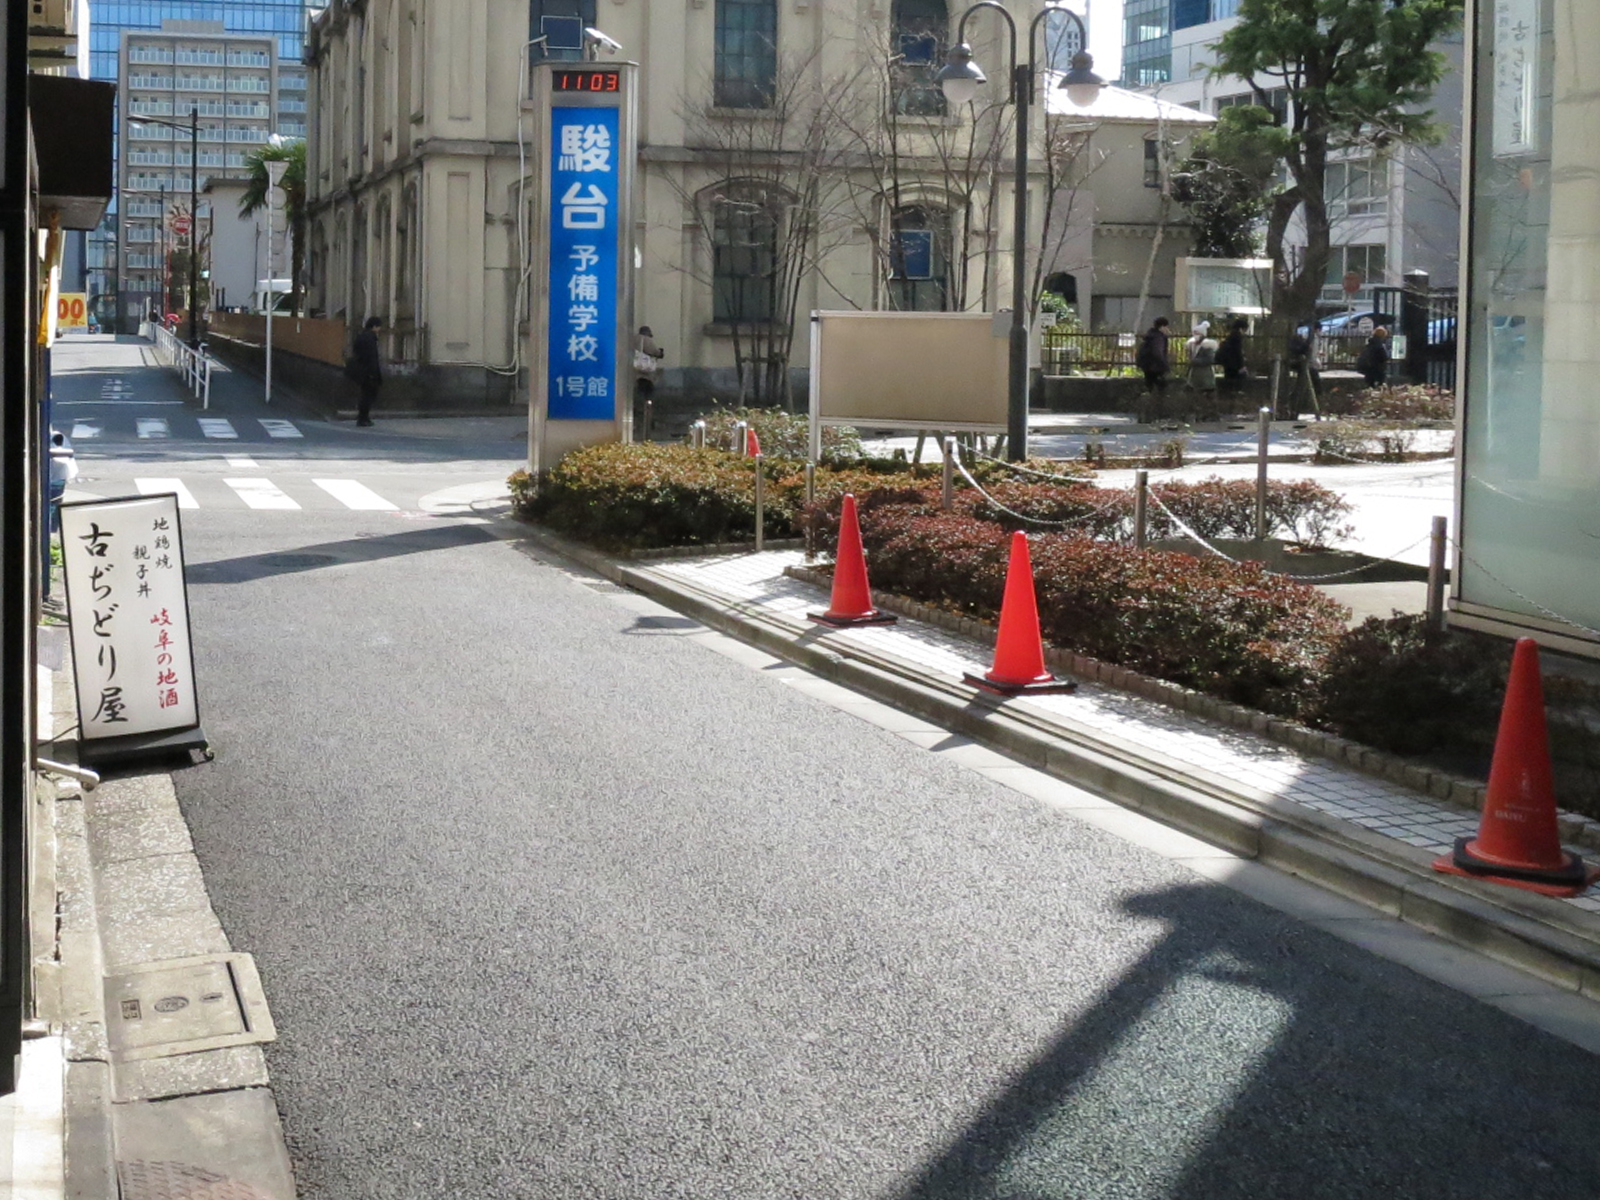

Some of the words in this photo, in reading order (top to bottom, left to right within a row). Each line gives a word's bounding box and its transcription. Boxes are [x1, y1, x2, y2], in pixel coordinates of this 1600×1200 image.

[556, 375, 609, 397] 1号館
[78, 522, 128, 724] 古ぢどり屋
[150, 607, 179, 709] 岐阜の地酒
